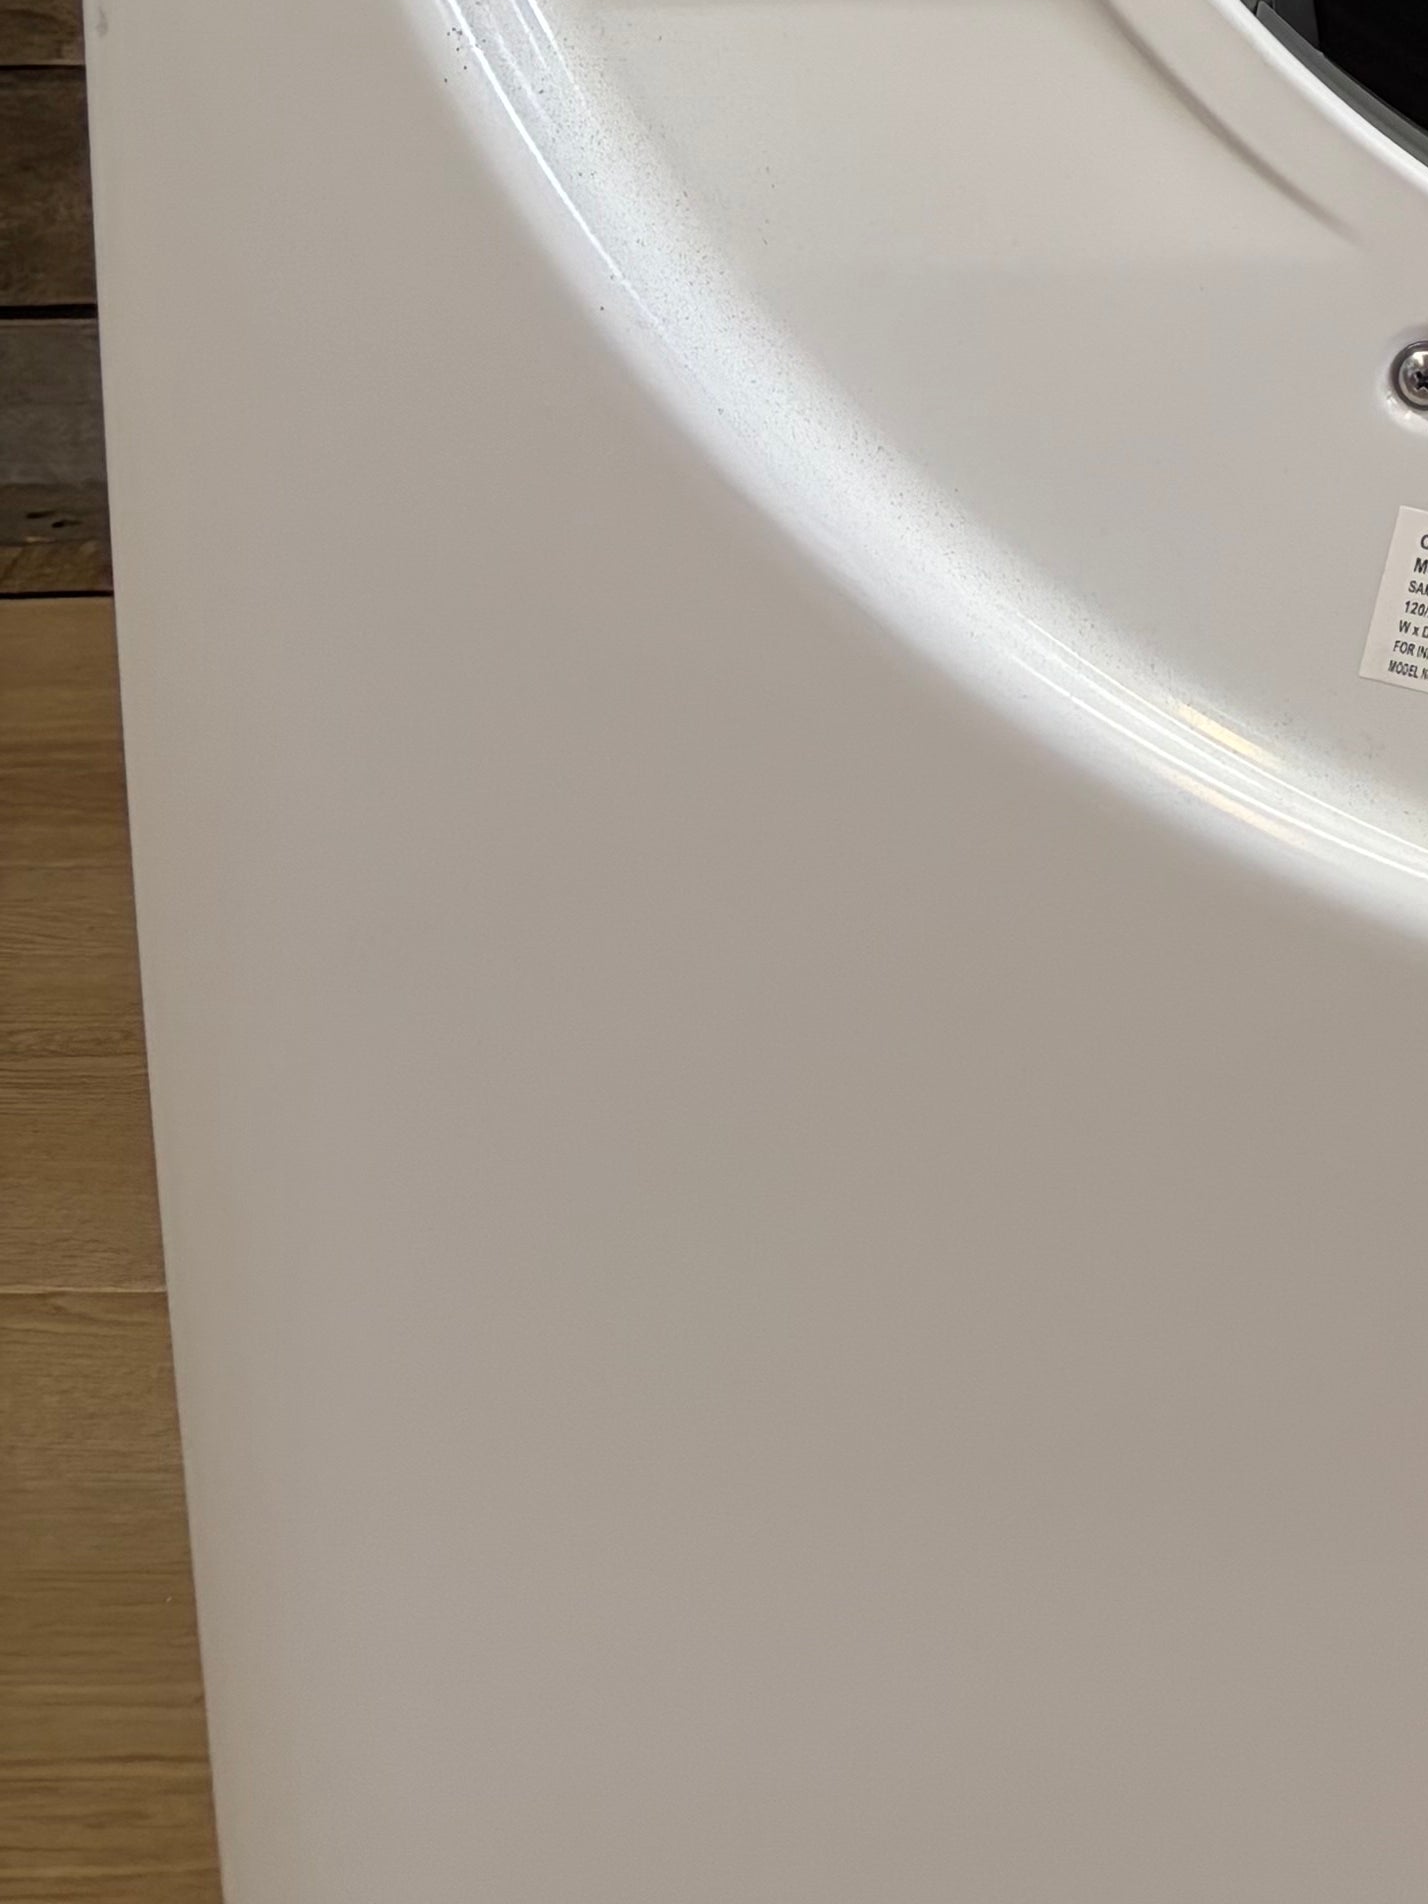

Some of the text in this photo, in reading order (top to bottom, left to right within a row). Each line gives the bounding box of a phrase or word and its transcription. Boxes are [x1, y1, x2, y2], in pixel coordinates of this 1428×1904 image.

[1398, 621, 1411, 634] W
[1393, 640, 1415, 656] FOR
[1388, 660, 1419, 678] MODEL
